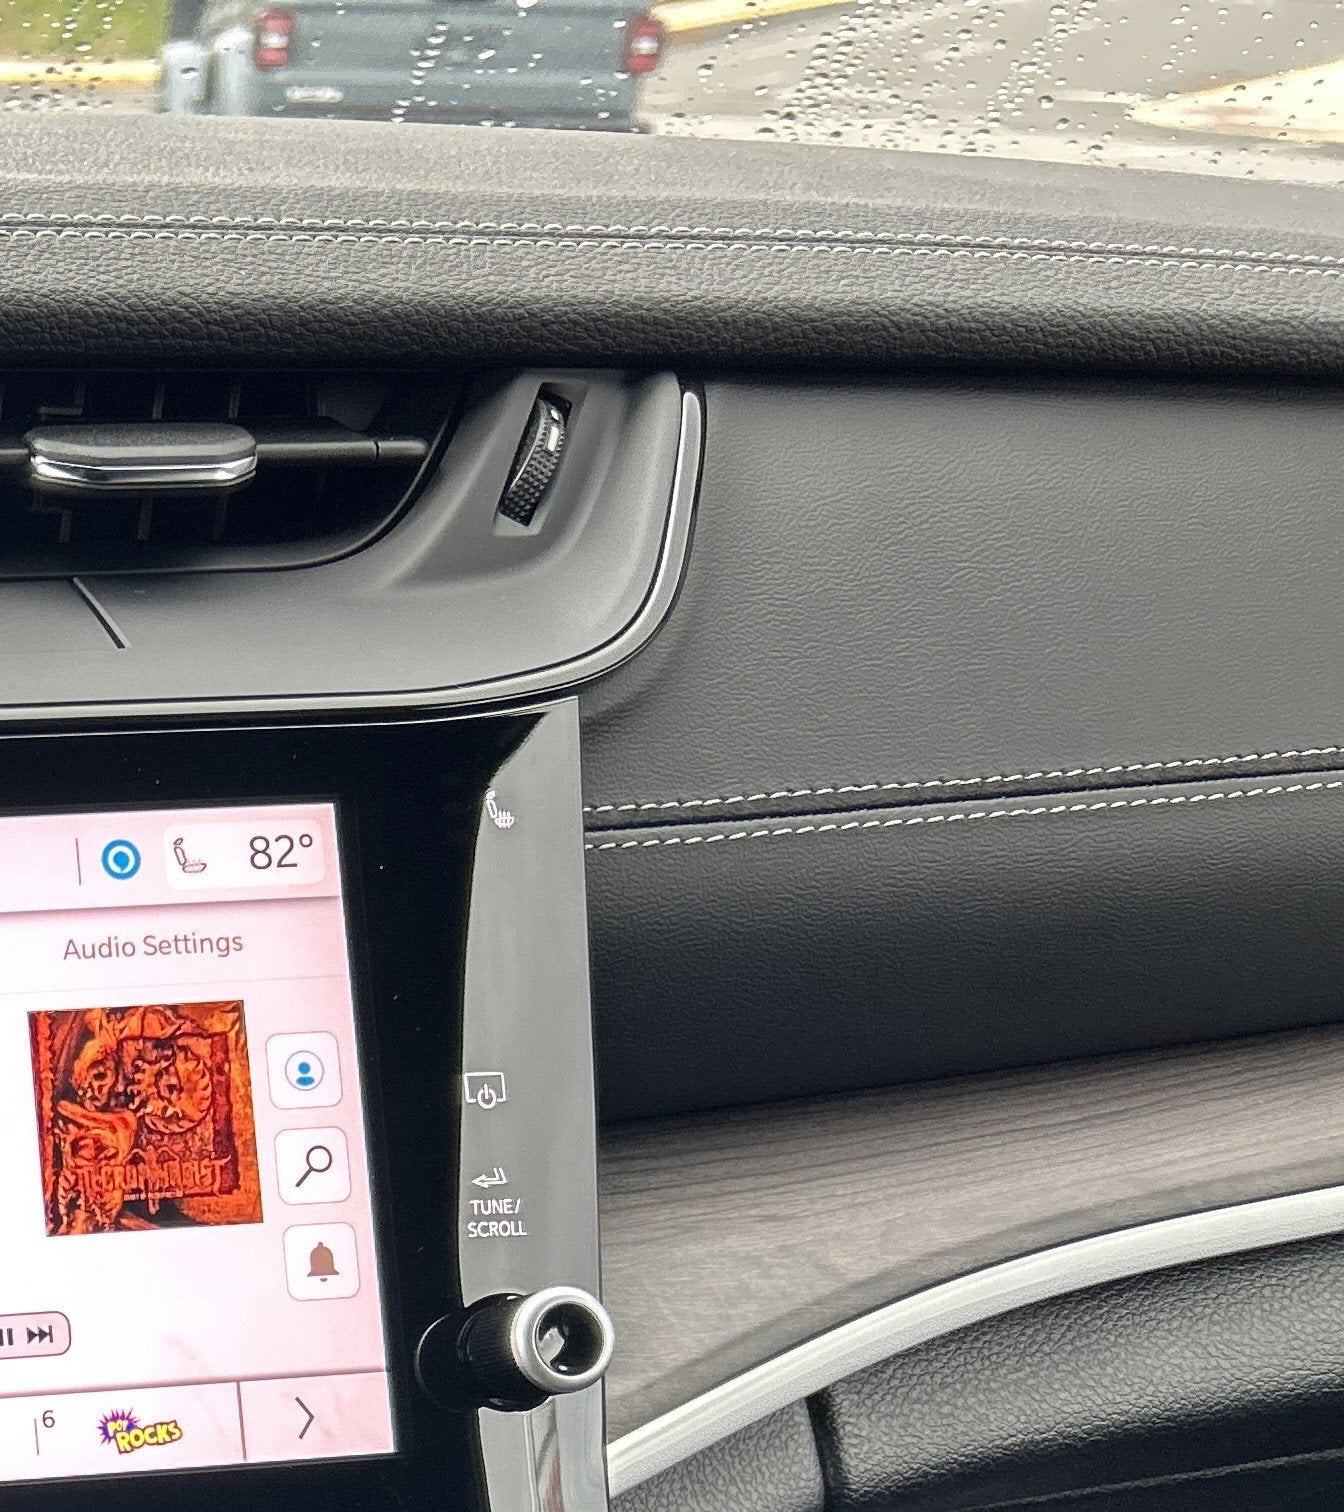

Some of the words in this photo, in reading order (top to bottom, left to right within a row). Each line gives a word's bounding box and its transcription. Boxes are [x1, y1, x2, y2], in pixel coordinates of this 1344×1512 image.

[249, 833, 313, 870] 82°
[63, 935, 136, 961] Audio
[143, 931, 243, 960] Settings
[470, 1197, 521, 1216] TUNE/
[467, 1219, 527, 1239] SCROLL
[42, 1410, 55, 1428] 6
[116, 1421, 181, 1453] ROCKS
